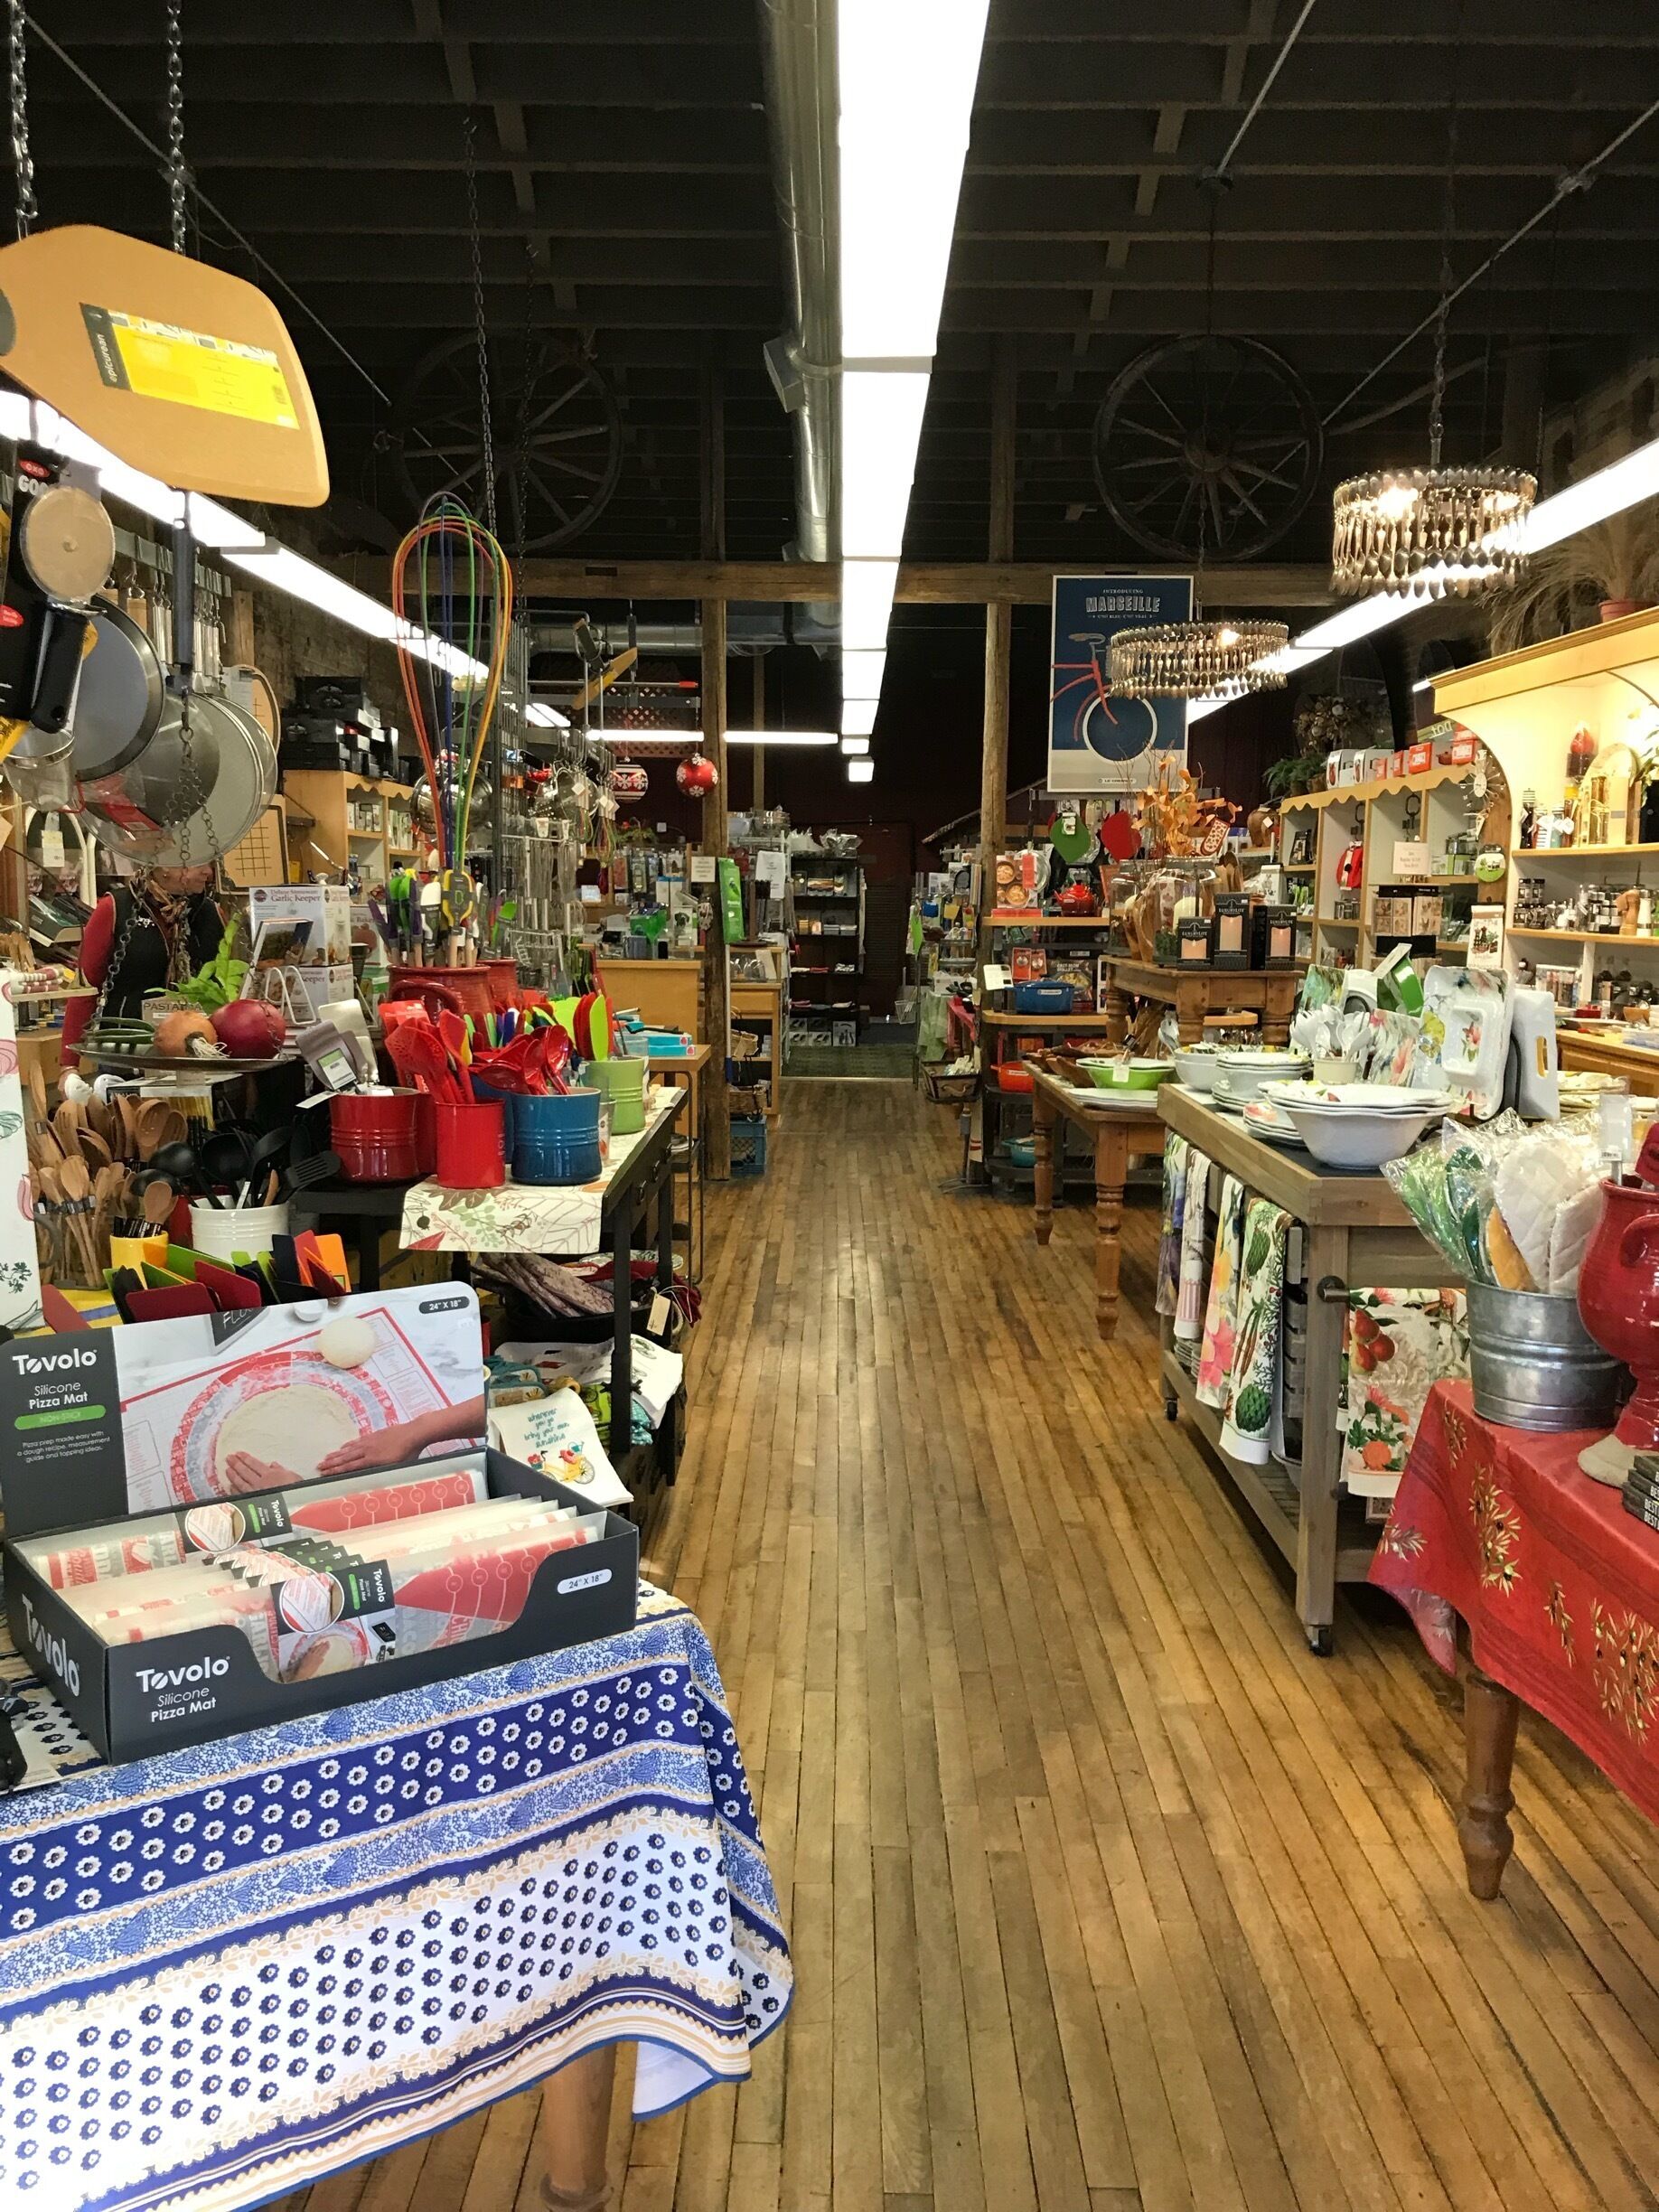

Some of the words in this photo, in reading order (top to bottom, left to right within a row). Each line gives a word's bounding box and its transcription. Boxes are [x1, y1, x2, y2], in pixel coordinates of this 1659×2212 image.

[97, 333, 117, 382] epicurean
[25, 463, 44, 475] OXO
[18, 474, 49, 496] GOO
[1085, 595, 1160, 613] MARSEILLE
[295, 895, 321, 903] Keeper
[428, 1301, 443, 1311] 24"
[444, 1301, 449, 1309] X
[450, 1299, 462, 1308] 18"
[12, 1348, 97, 1375] Tovolo
[34, 1382, 81, 1397] Silicone
[29, 1396, 61, 1410] Pizza
[63, 1392, 89, 1405] Mat
[271, 1499, 284, 1527] Tovolo
[372, 1568, 387, 1603] Tovolo
[568, 1579, 582, 1589] 24"
[583, 1577, 589, 1585] X
[591, 1573, 603, 1583] 18"
[22, 1593, 80, 1697] Tovolo
[136, 1656, 230, 1692] Tovolo
[157, 1687, 210, 1708] Silicone
[151, 1706, 185, 1723] Pizza
[190, 1698, 217, 1714] Mat
